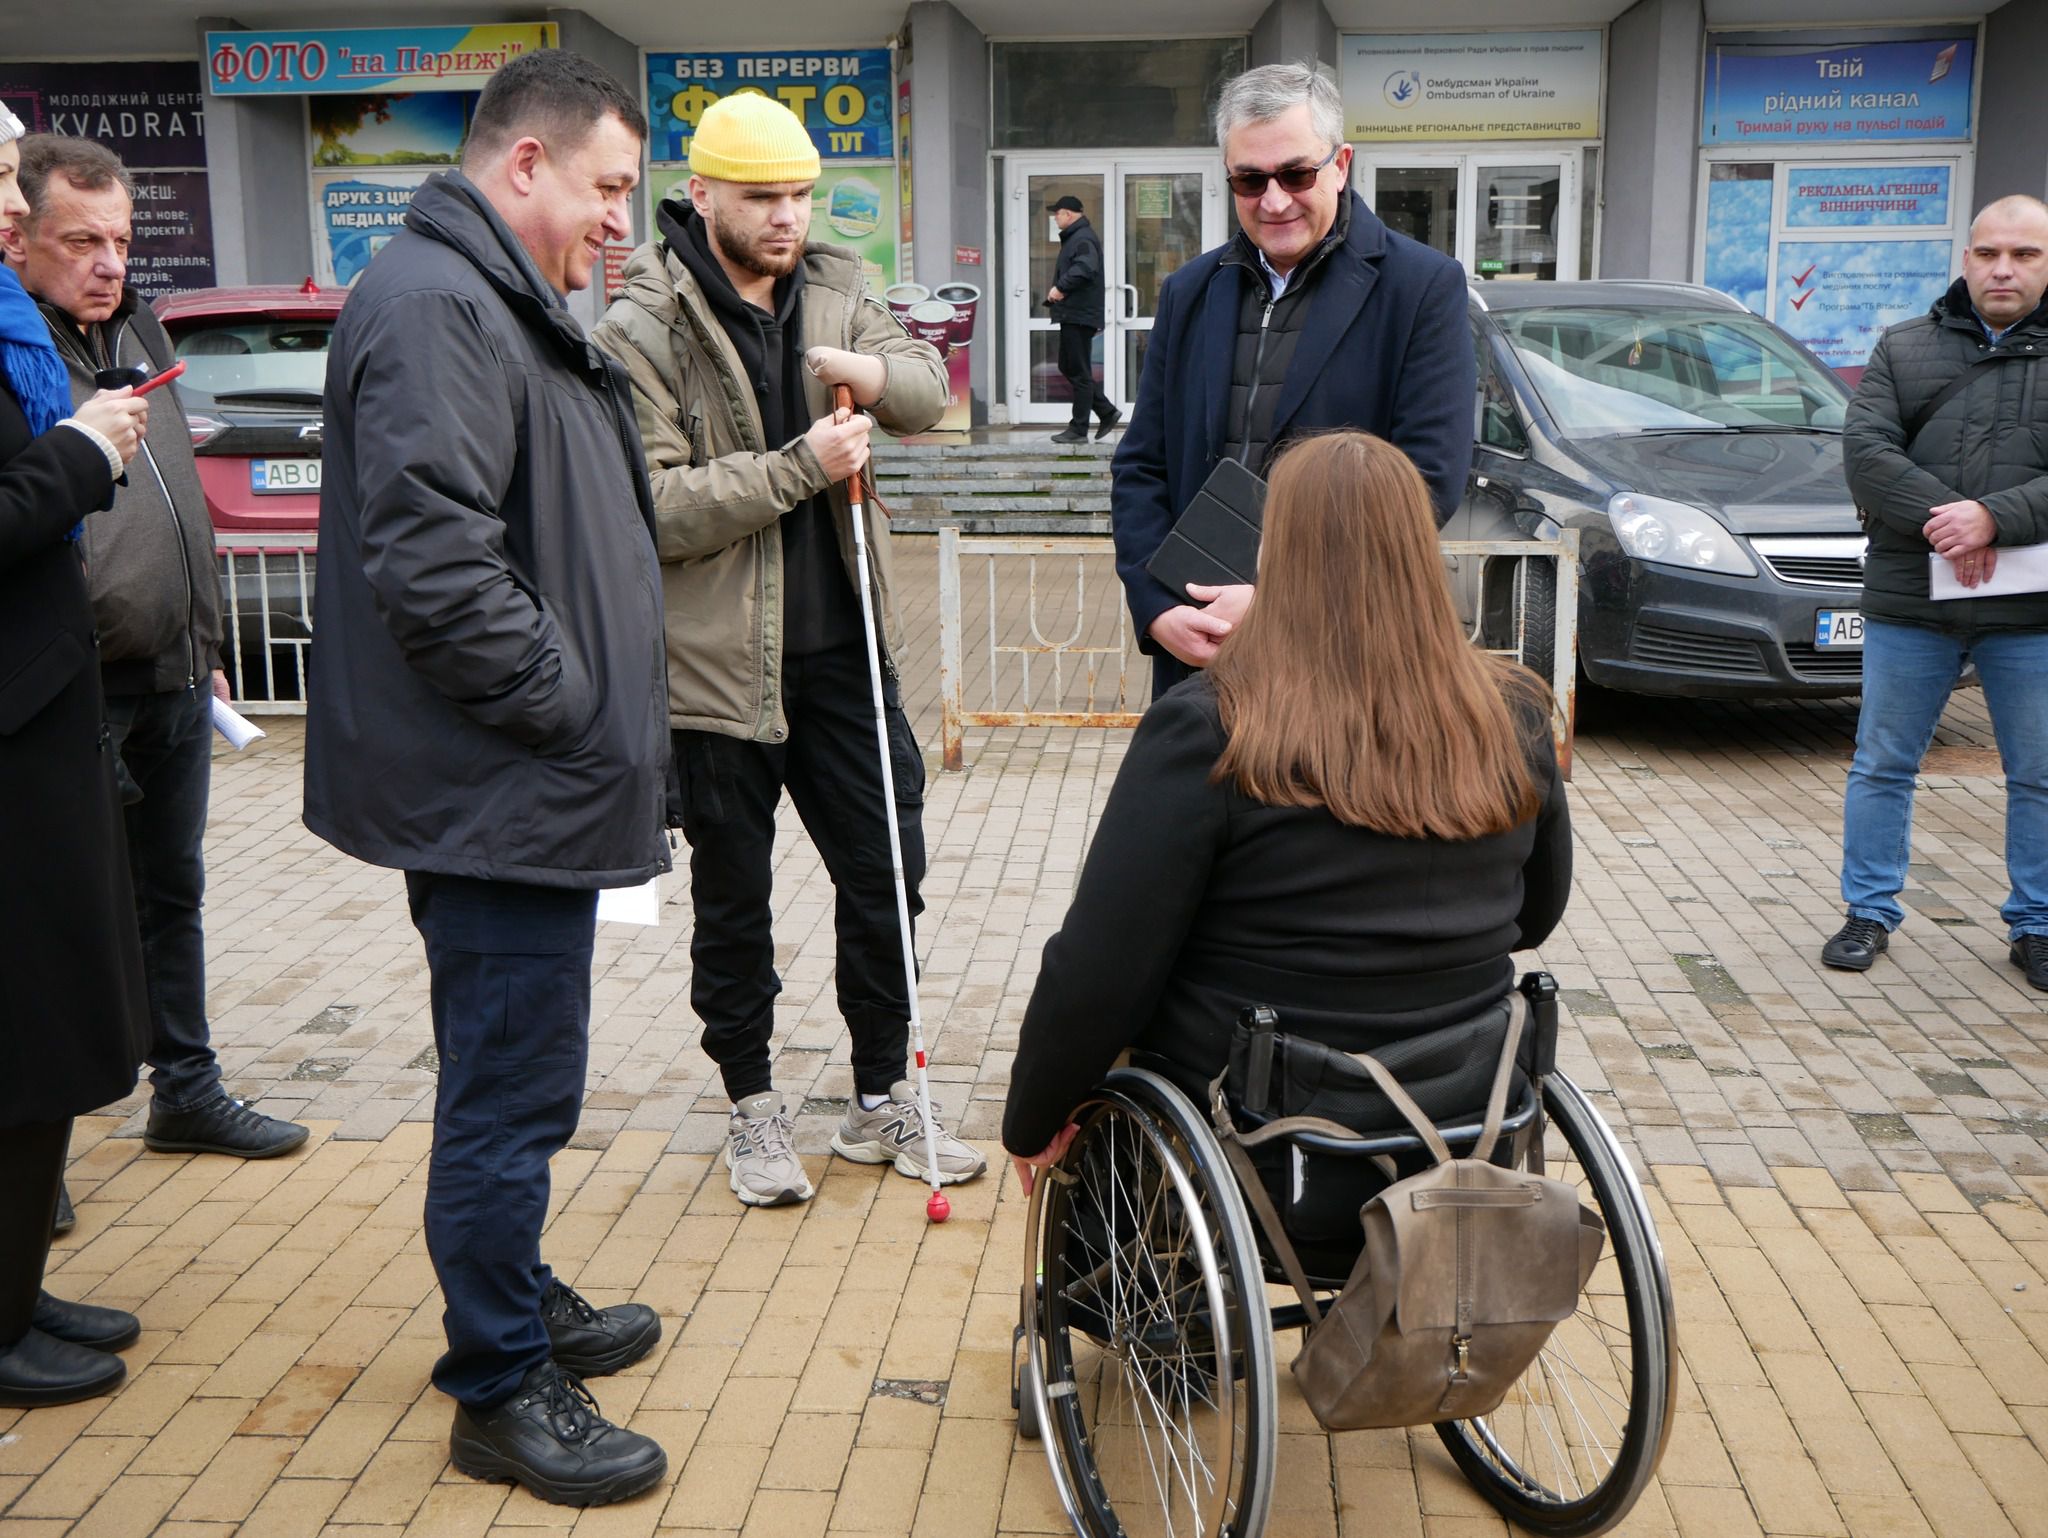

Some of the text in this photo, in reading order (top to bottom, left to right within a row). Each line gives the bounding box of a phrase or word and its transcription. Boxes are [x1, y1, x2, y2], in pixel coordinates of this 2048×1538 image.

[210, 41, 522, 83] ФОТО "на Парижі"
[675, 57, 860, 78] БЕЗ ПЕРЕРВИ
[1816, 57, 1864, 79] Твій
[1426, 77, 1539, 89] Омбудсман України
[49, 92, 149, 107] МОЛОДІЖНИЙ
[1426, 89, 1556, 100] Ombudsman of Ukraine
[1764, 89, 1920, 114] рідний канал
[671, 84, 866, 127] ФТО
[51, 112, 204, 138] KVADRAT
[1355, 122, 1582, 133] ВІННИЦЬКЕ РЕГІОНАЛЬНЕ ПРЕДСТАВНИЦТВО
[1736, 115, 1945, 135] Тримай руку на пульсі подій
[828, 132, 865, 152] ТУТ
[1798, 183, 1938, 197] РЕКЛАМНА АГЕНЦІЯ
[327, 192, 371, 207] ДРУК
[387, 191, 417, 206] ЦИ
[1819, 199, 1917, 212] ВІННИЧЧИНИ
[156, 211, 189, 221] нове;
[331, 213, 384, 227] МЕДІА
[137, 226, 185, 239] проєкти
[152, 254, 211, 268] дозвілля;
[130, 270, 173, 284] друзів;
[268, 464, 301, 485] AB
[1833, 617, 1864, 640] AB
